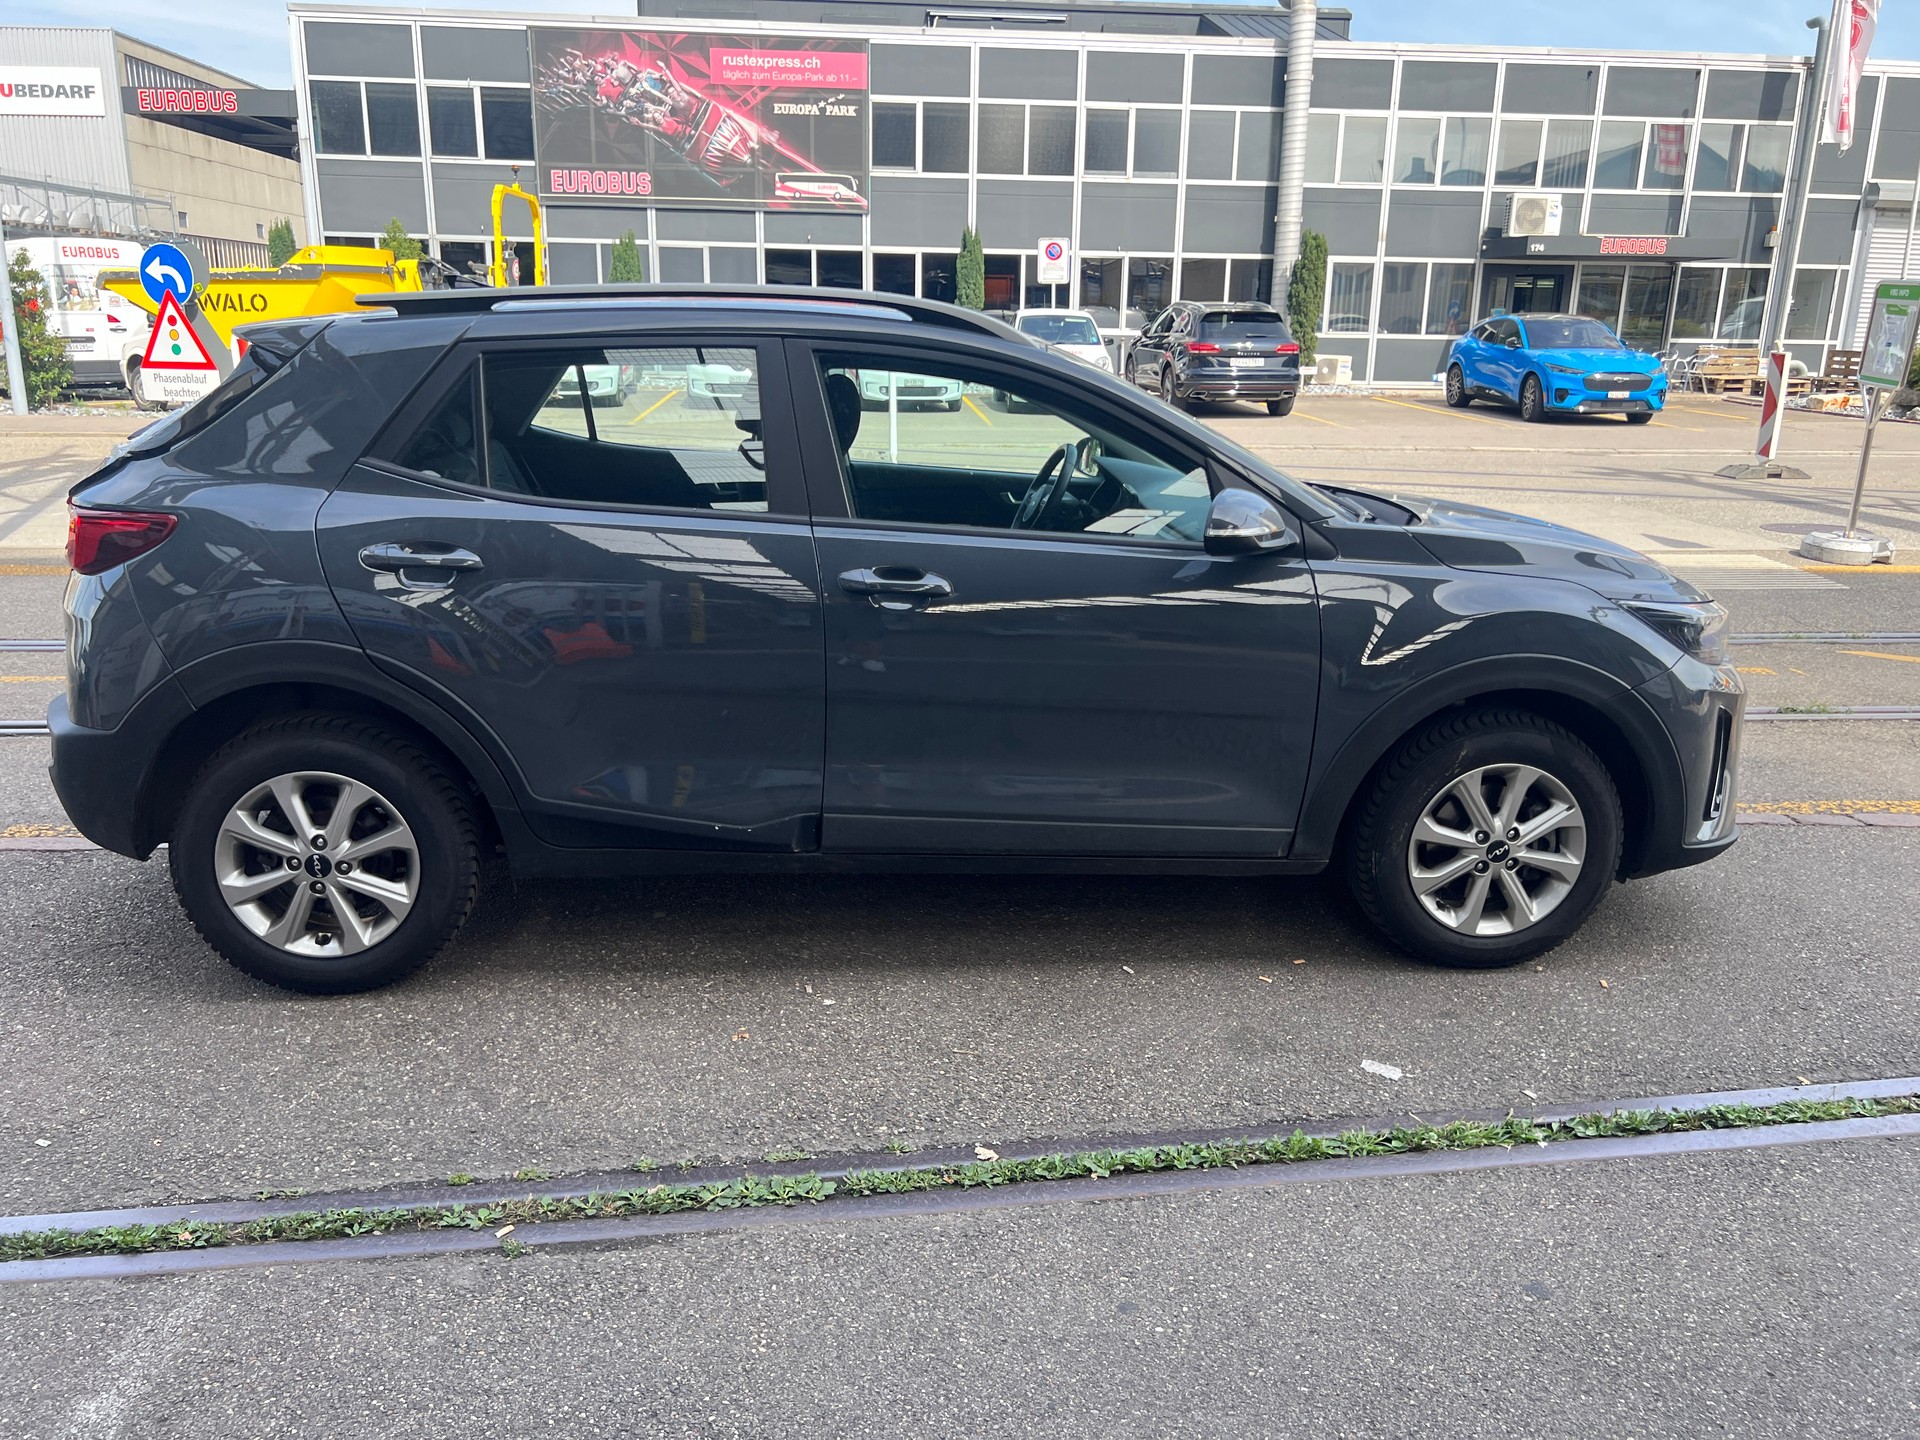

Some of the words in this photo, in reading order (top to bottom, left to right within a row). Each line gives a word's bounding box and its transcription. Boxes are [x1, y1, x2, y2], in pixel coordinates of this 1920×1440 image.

[722, 54, 821, 69] rustexpress.ch
[723, 70, 750, 81] täglich
[772, 71, 824, 82] Europa-Park
[826, 74, 837, 82] ab
[137, 89, 238, 113] EUROBUS
[773, 103, 820, 115] EUROPA
[825, 105, 857, 117] PARK
[550, 170, 652, 195] EUROBUS
[62, 246, 119, 259] EUROBUS
[1530, 244, 1544, 252] 174
[1600, 238, 1667, 254] EUROBUS
[197, 293, 268, 312] WALO
[153, 372, 207, 384] Phasenablauf
[164, 387, 200, 397] beachten
